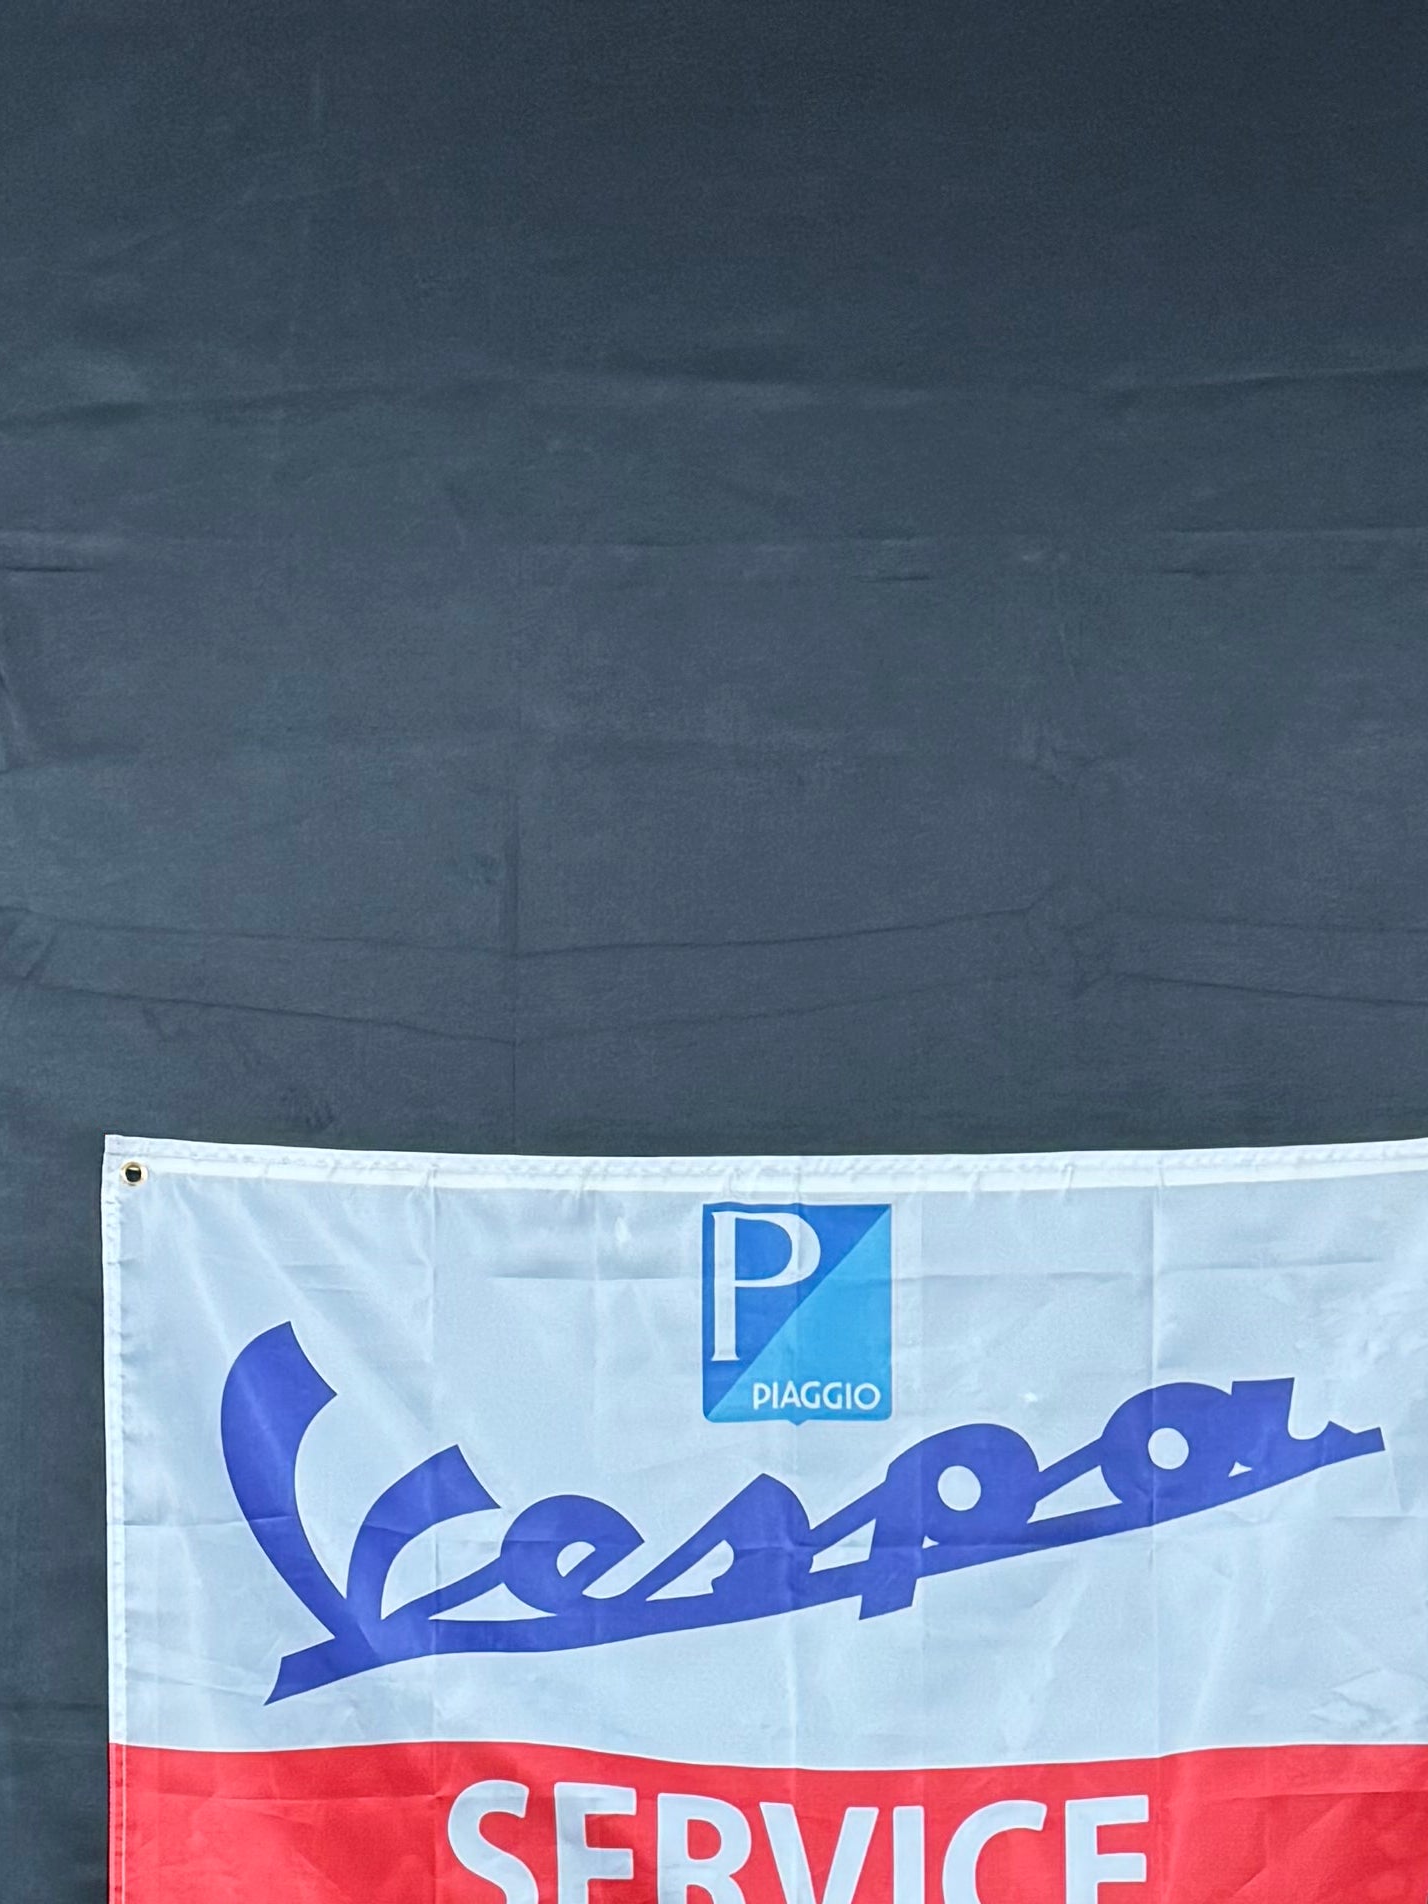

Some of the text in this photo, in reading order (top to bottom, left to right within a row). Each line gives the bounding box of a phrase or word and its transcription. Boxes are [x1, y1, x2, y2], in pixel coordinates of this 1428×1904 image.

[710, 1209, 822, 1362] P
[752, 1380, 882, 1411] PIAGGIO
[220, 1320, 1385, 1706] Vespa
